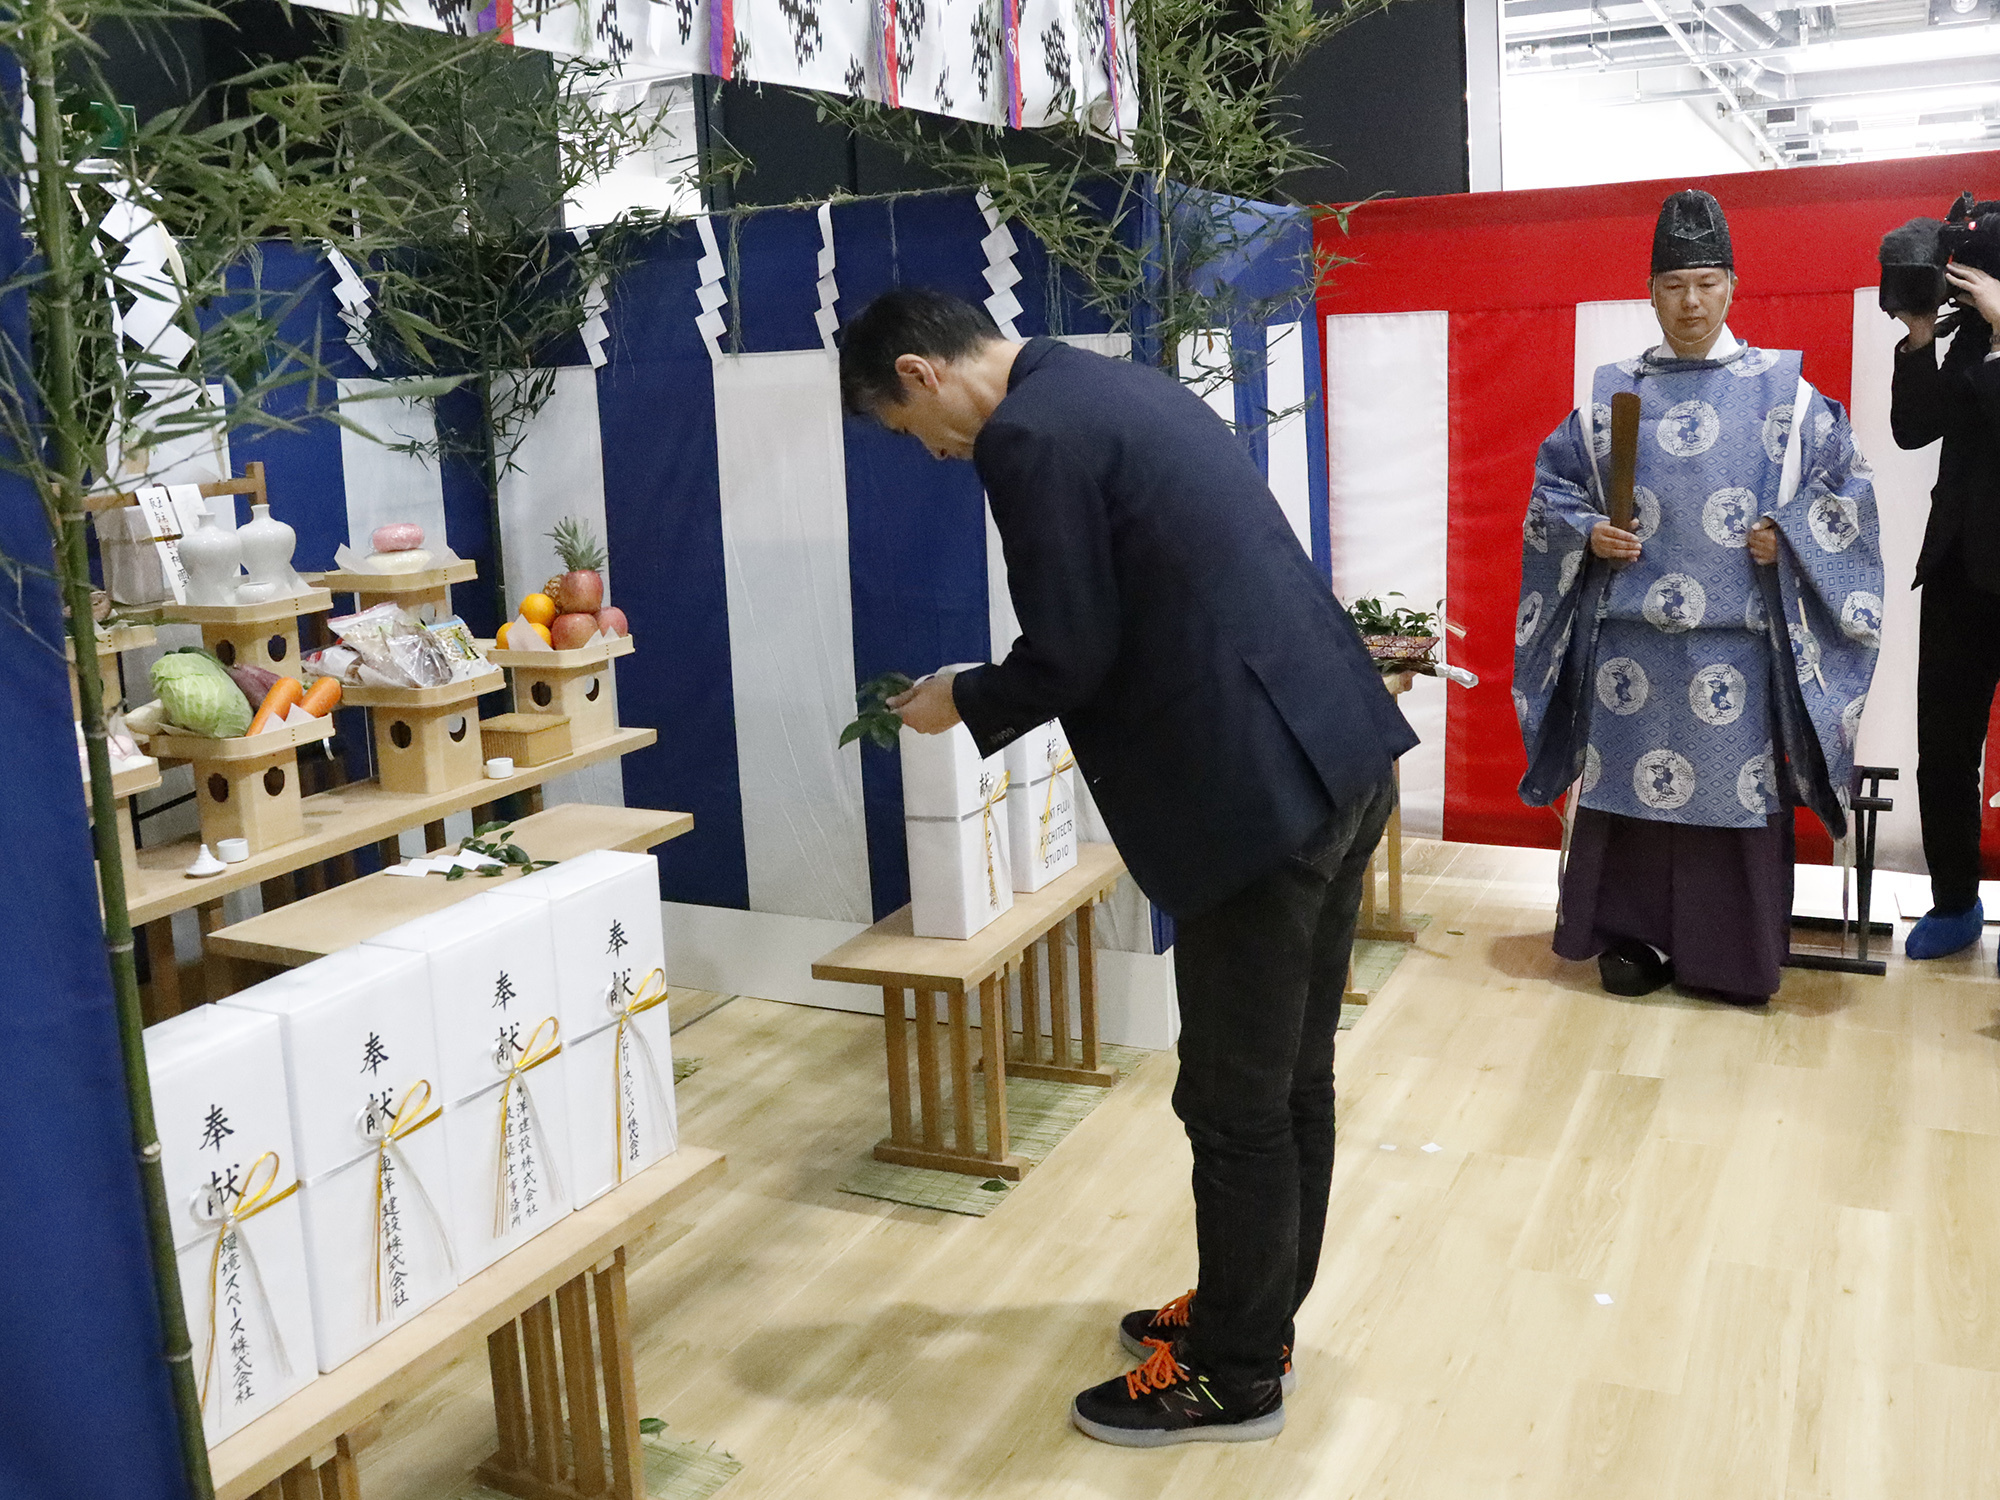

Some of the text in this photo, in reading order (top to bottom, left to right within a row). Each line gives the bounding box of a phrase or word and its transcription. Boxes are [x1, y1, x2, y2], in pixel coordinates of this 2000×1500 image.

[1040, 820, 1073, 849] ARCHITECTS
[1045, 844, 1069, 869] STUDIO
[220, 1231, 256, 1407] 環境スペース株式会社
